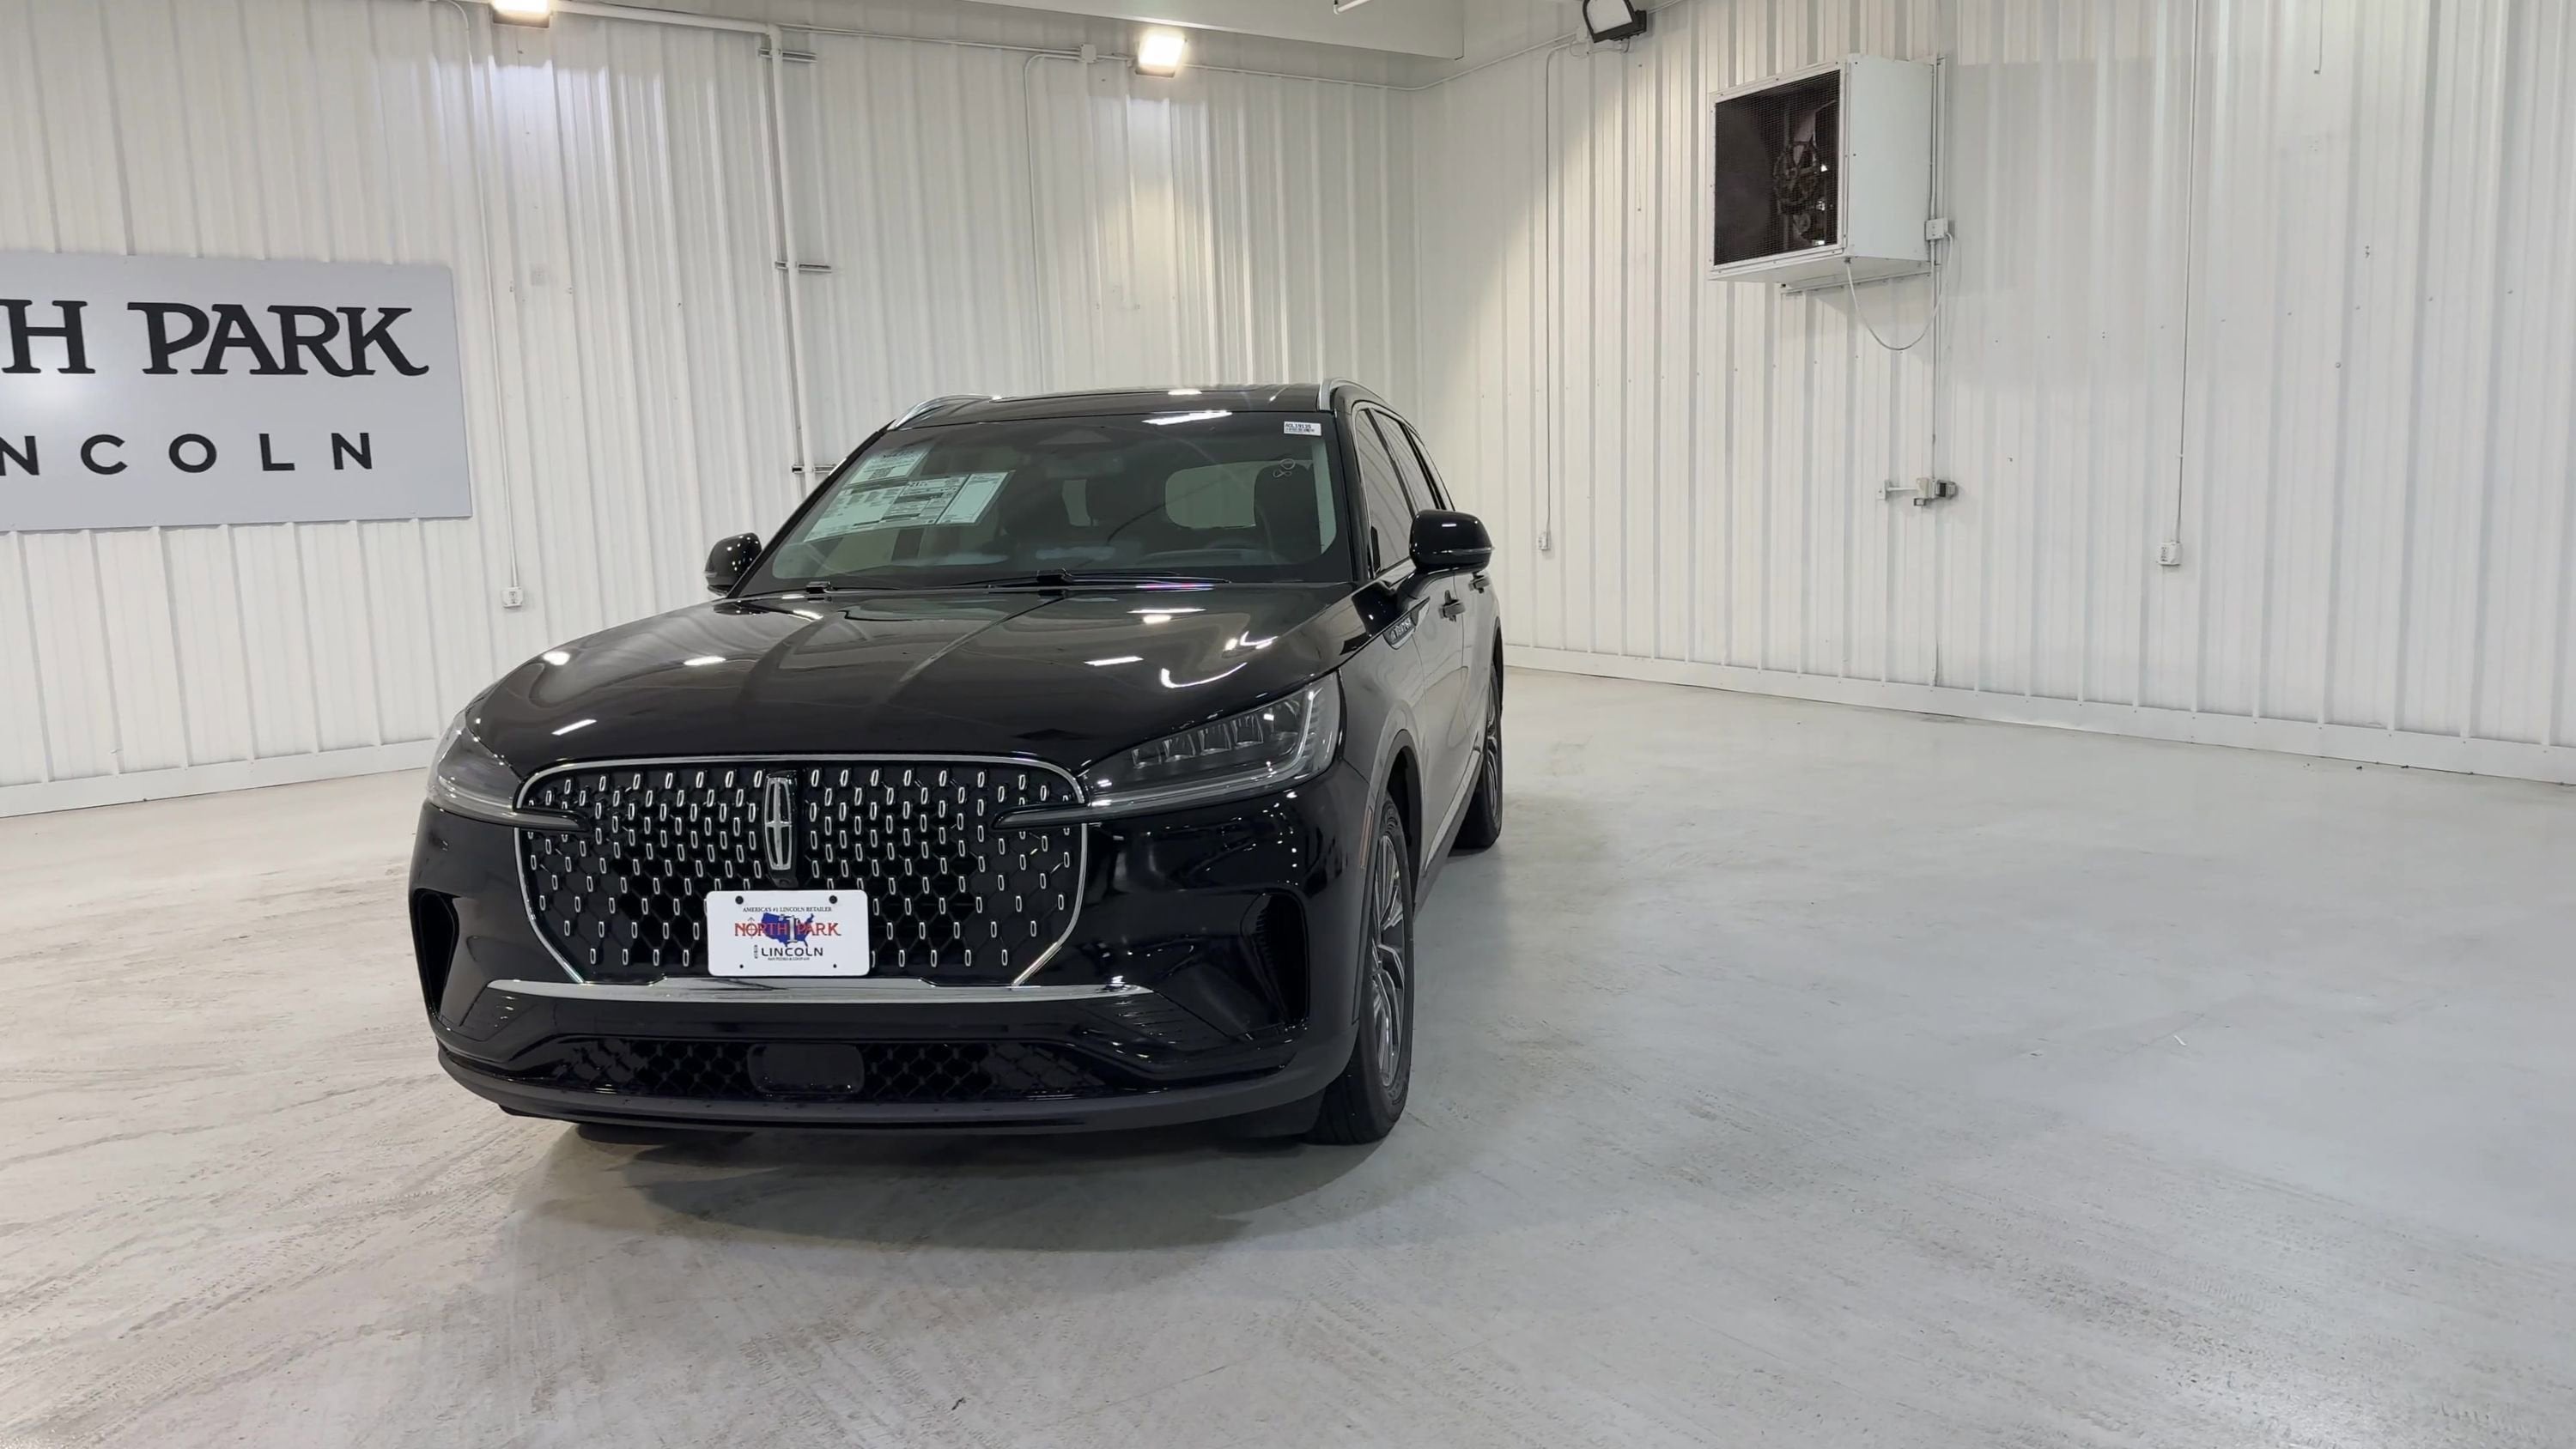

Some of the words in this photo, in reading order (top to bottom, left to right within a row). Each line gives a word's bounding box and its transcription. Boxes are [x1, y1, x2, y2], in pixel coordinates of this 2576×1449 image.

[127, 302, 428, 376] PARK
[734, 922, 788, 937] NORTH
[797, 922, 841, 937] PARK
[761, 947, 823, 957] LINCOLN
